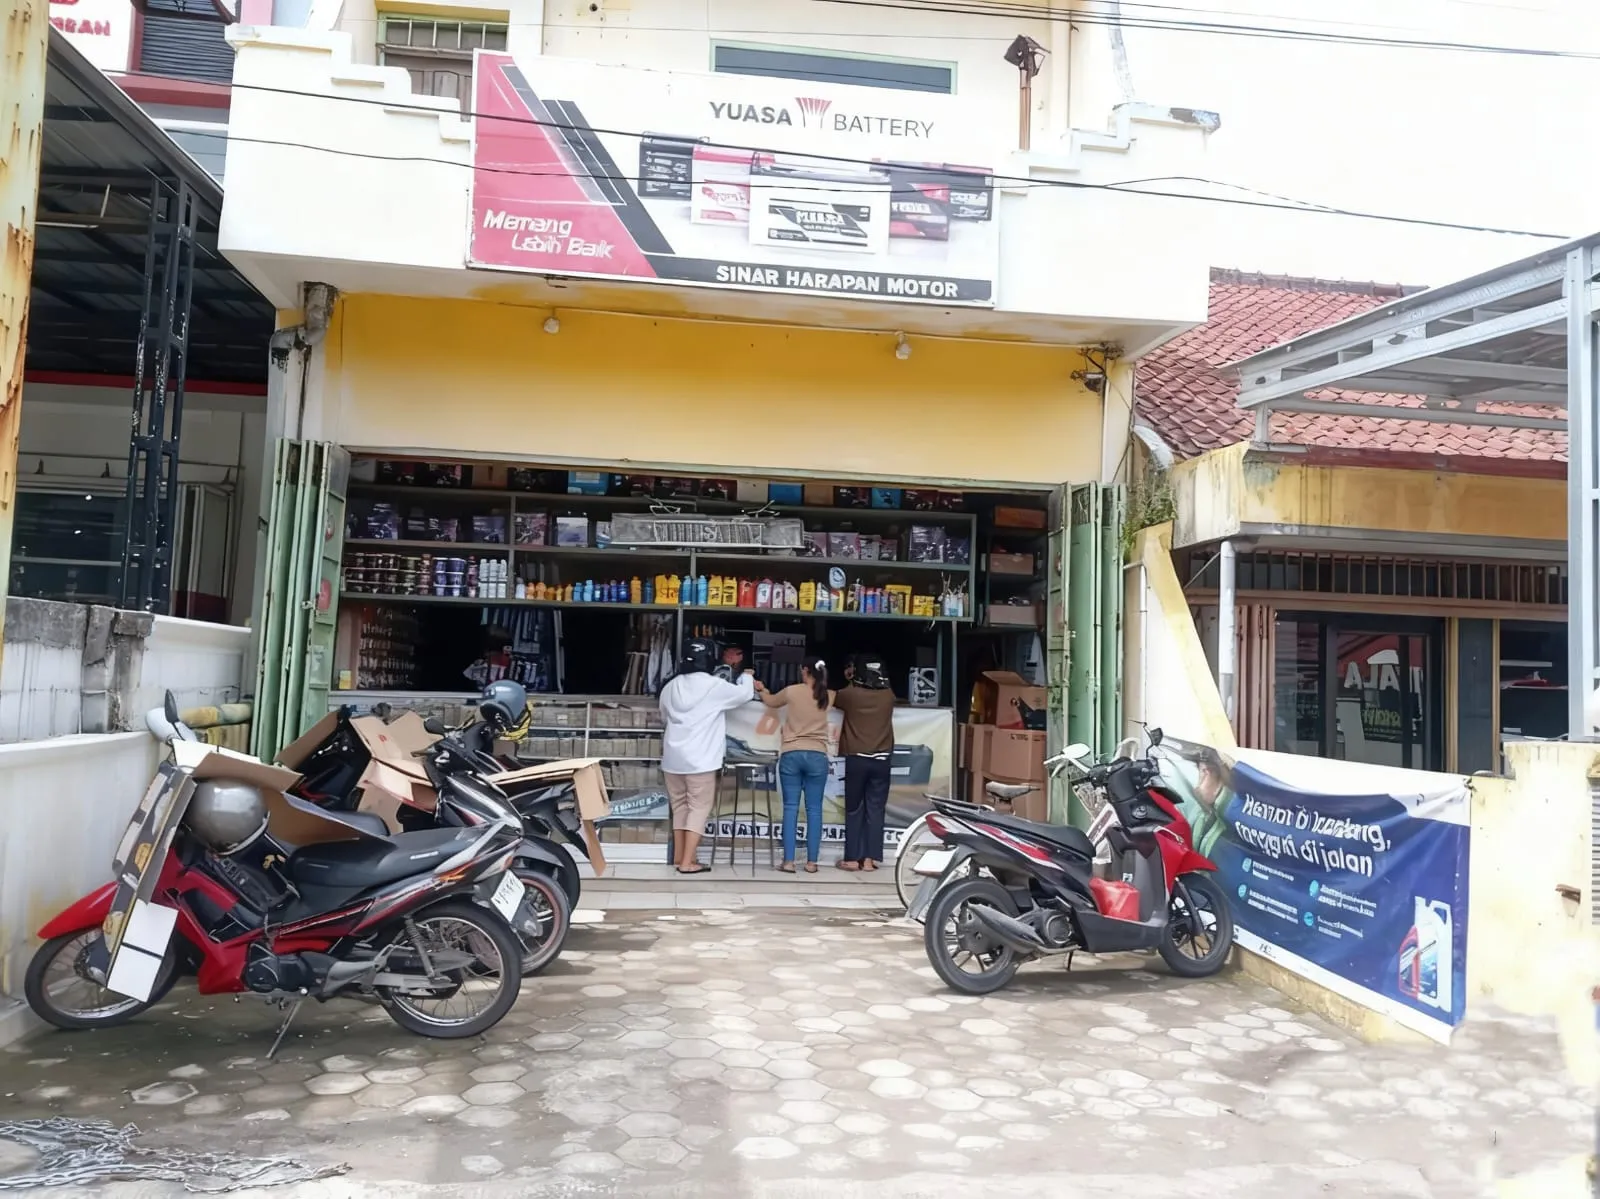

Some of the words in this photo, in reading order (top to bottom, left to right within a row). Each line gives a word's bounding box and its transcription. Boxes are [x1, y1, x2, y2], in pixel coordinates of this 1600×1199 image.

[709, 101, 793, 126] YUASA
[834, 113, 935, 138] BATTERY
[716, 265, 779, 285] SINAR
[786, 270, 880, 292] HARAPAN
[887, 277, 959, 298] MOTOR
[1320, 842, 1373, 878] jalan
